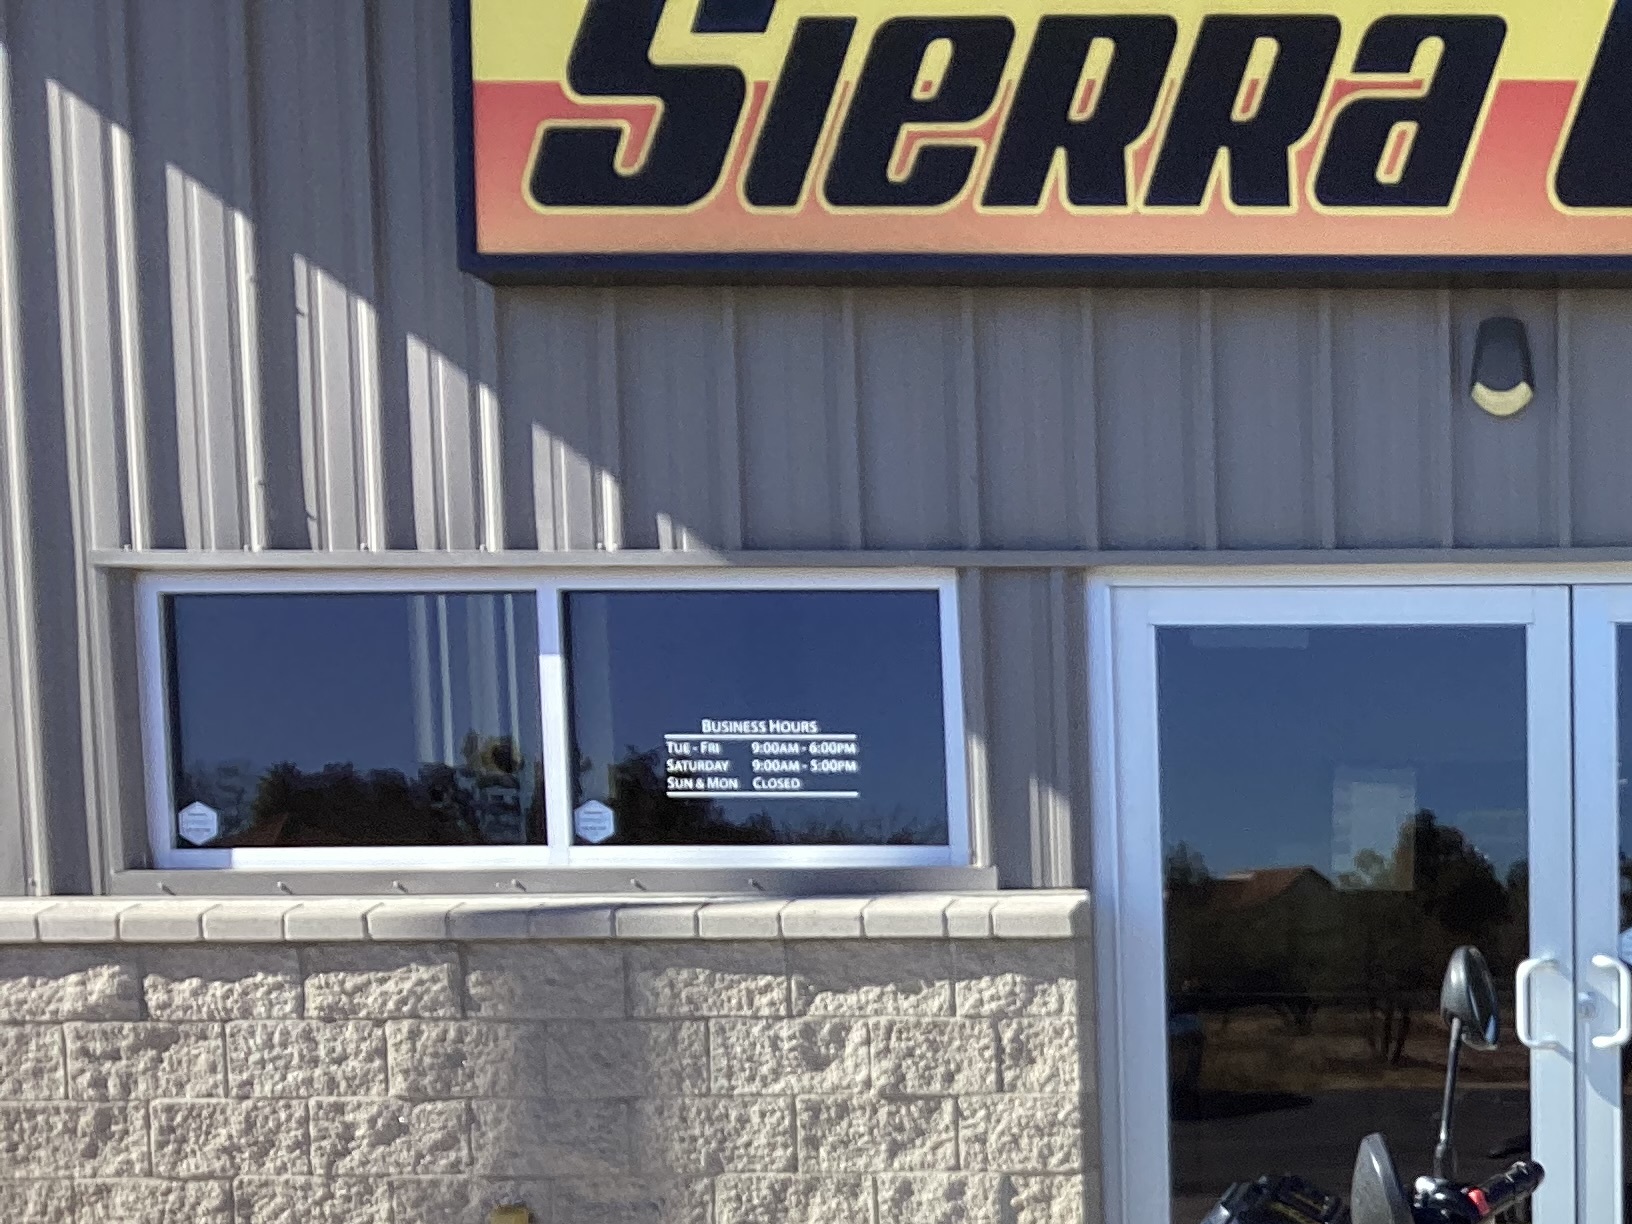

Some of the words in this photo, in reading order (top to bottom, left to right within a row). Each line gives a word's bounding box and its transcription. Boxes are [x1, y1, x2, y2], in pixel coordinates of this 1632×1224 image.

[751, 741, 800, 755] 9:00AM
[808, 741, 857, 755] 6:00PM
[752, 758, 801, 773] 9:00AM
[809, 758, 858, 773] 5:00PM
[695, 777, 705, 790] &
